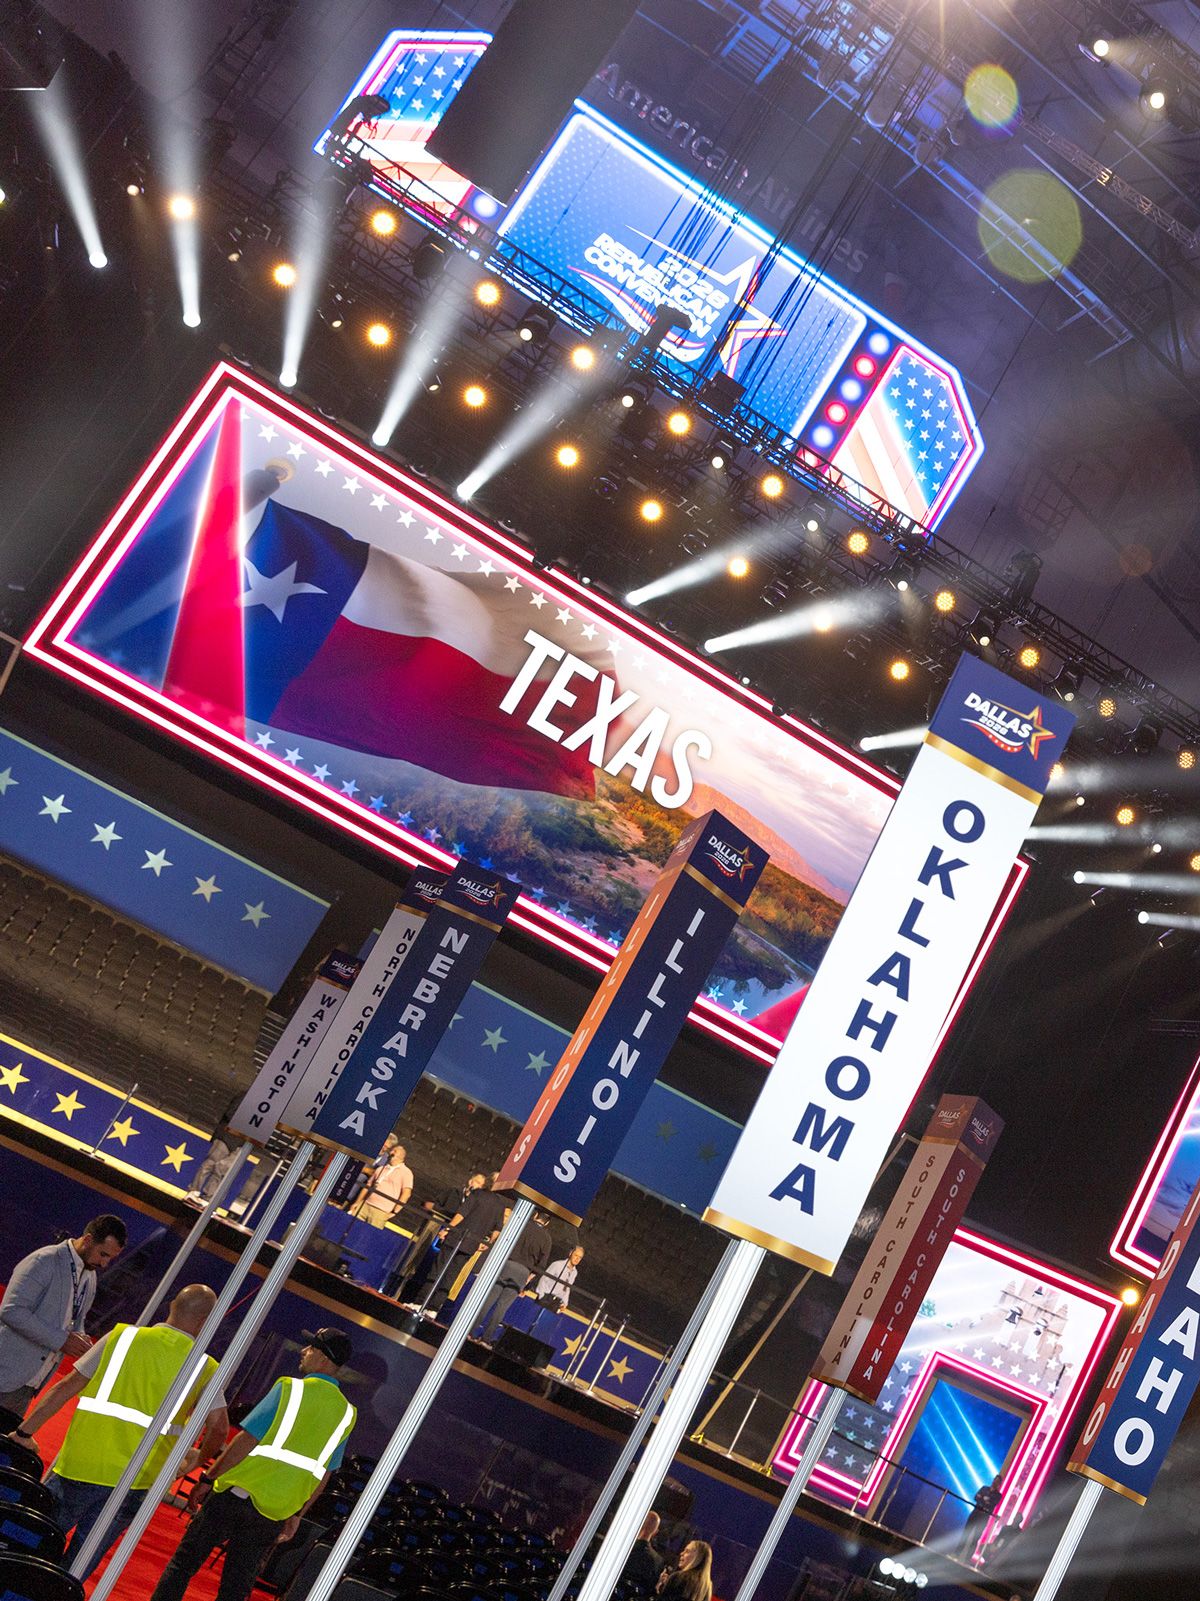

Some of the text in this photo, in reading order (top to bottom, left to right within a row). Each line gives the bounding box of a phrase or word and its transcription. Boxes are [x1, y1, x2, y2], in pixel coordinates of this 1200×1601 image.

[593, 232, 721, 327] REPUBLICAN
[657, 256, 730, 310] 2026
[498, 629, 713, 809] TEXAS
[963, 692, 1033, 739] DALLAS
[978, 715, 1008, 736] 2026
[415, 881, 443, 896] DALLAS
[457, 877, 495, 898] DALLAS
[708, 835, 743, 867] DALLAS
[714, 851, 730, 865] 2026
[305, 928, 416, 1121] NORTH CAROLINA
[338, 926, 470, 1137] NEBRASKA
[513, 893, 660, 1163] ILLINOIS
[553, 908, 705, 1183] ILLINOIS
[768, 799, 986, 1217] OKLAHOMA
[248, 994, 337, 1128] WASHINGTON
[938, 1110, 960, 1119] DALLAS
[971, 1117, 990, 1137] DALLAS
[831, 1155, 936, 1366] SOUTH CAROLINA
[863, 1168, 966, 1381] SOUTH CAROLINA
